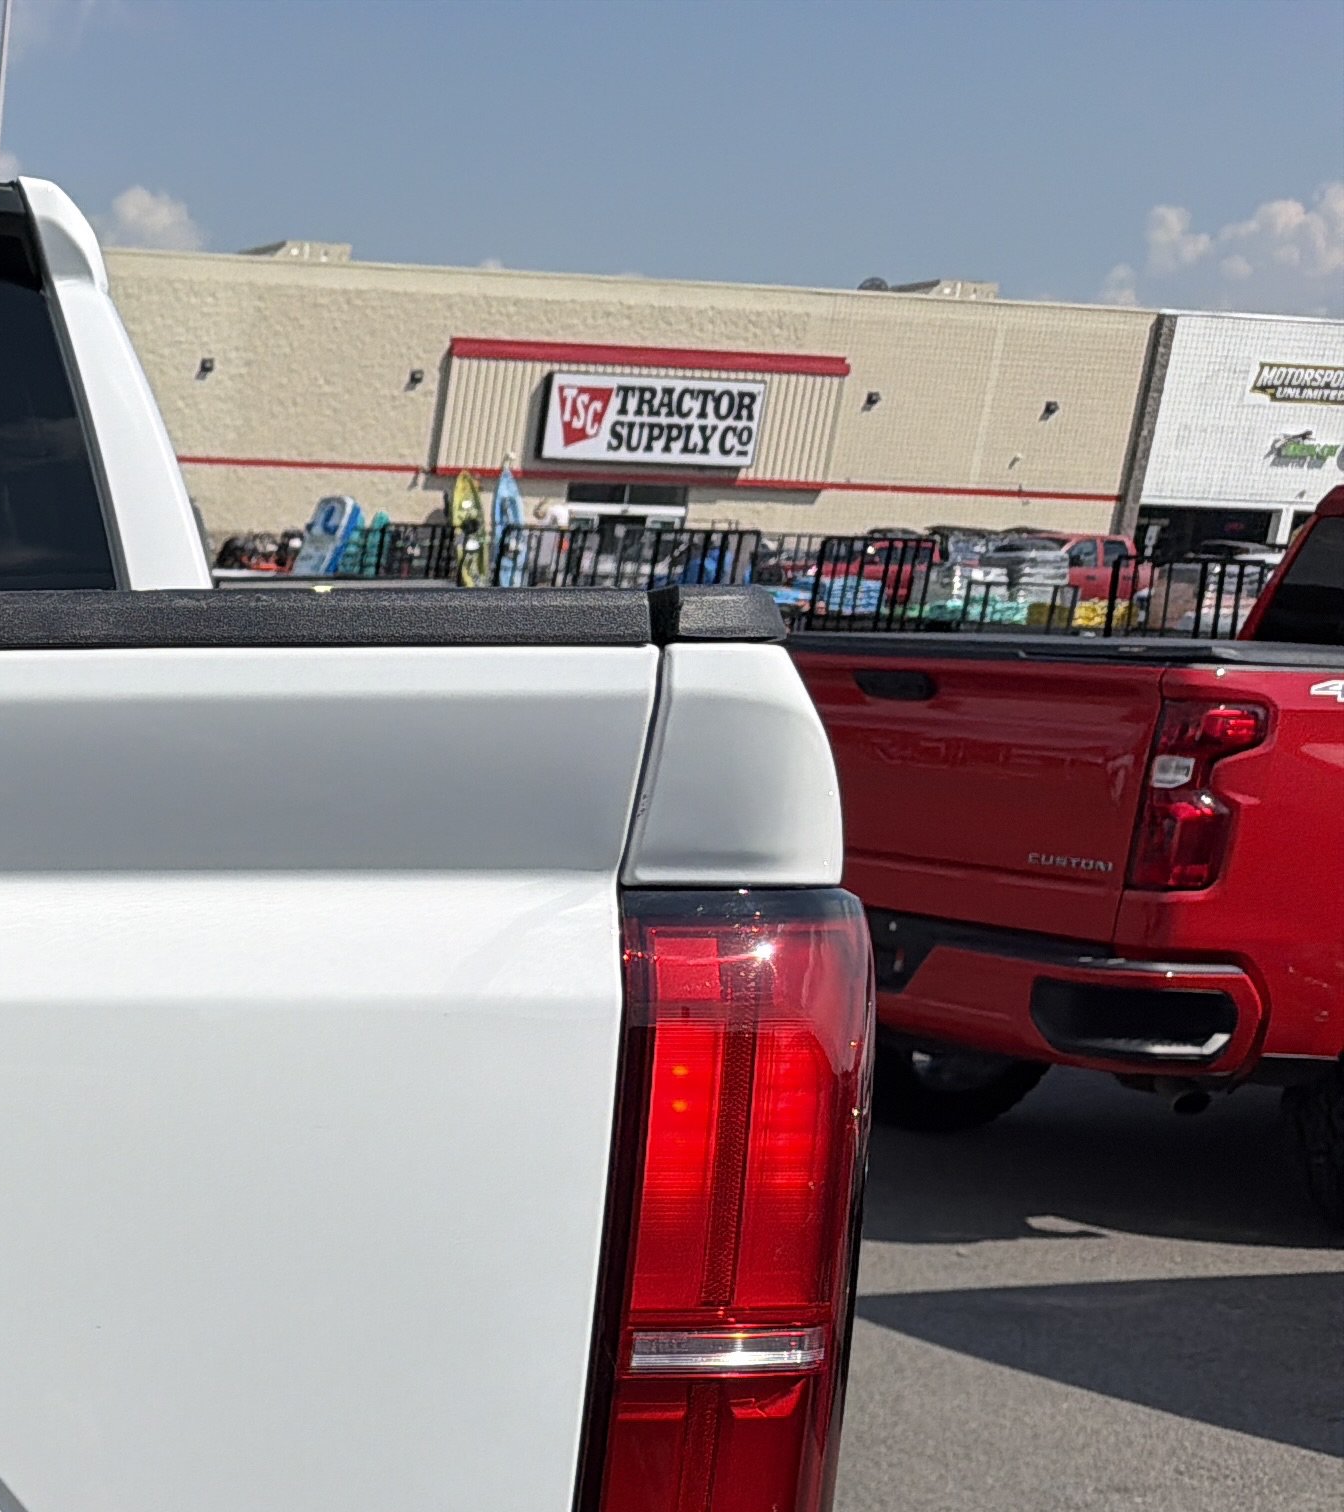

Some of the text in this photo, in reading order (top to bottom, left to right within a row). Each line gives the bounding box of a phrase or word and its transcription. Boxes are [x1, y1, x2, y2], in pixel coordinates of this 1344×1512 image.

[562, 387, 603, 436] TSC
[615, 385, 757, 421] TRACTOR
[608, 423, 715, 454] SUPPLY
[1027, 851, 1114, 872] CUSTOM
